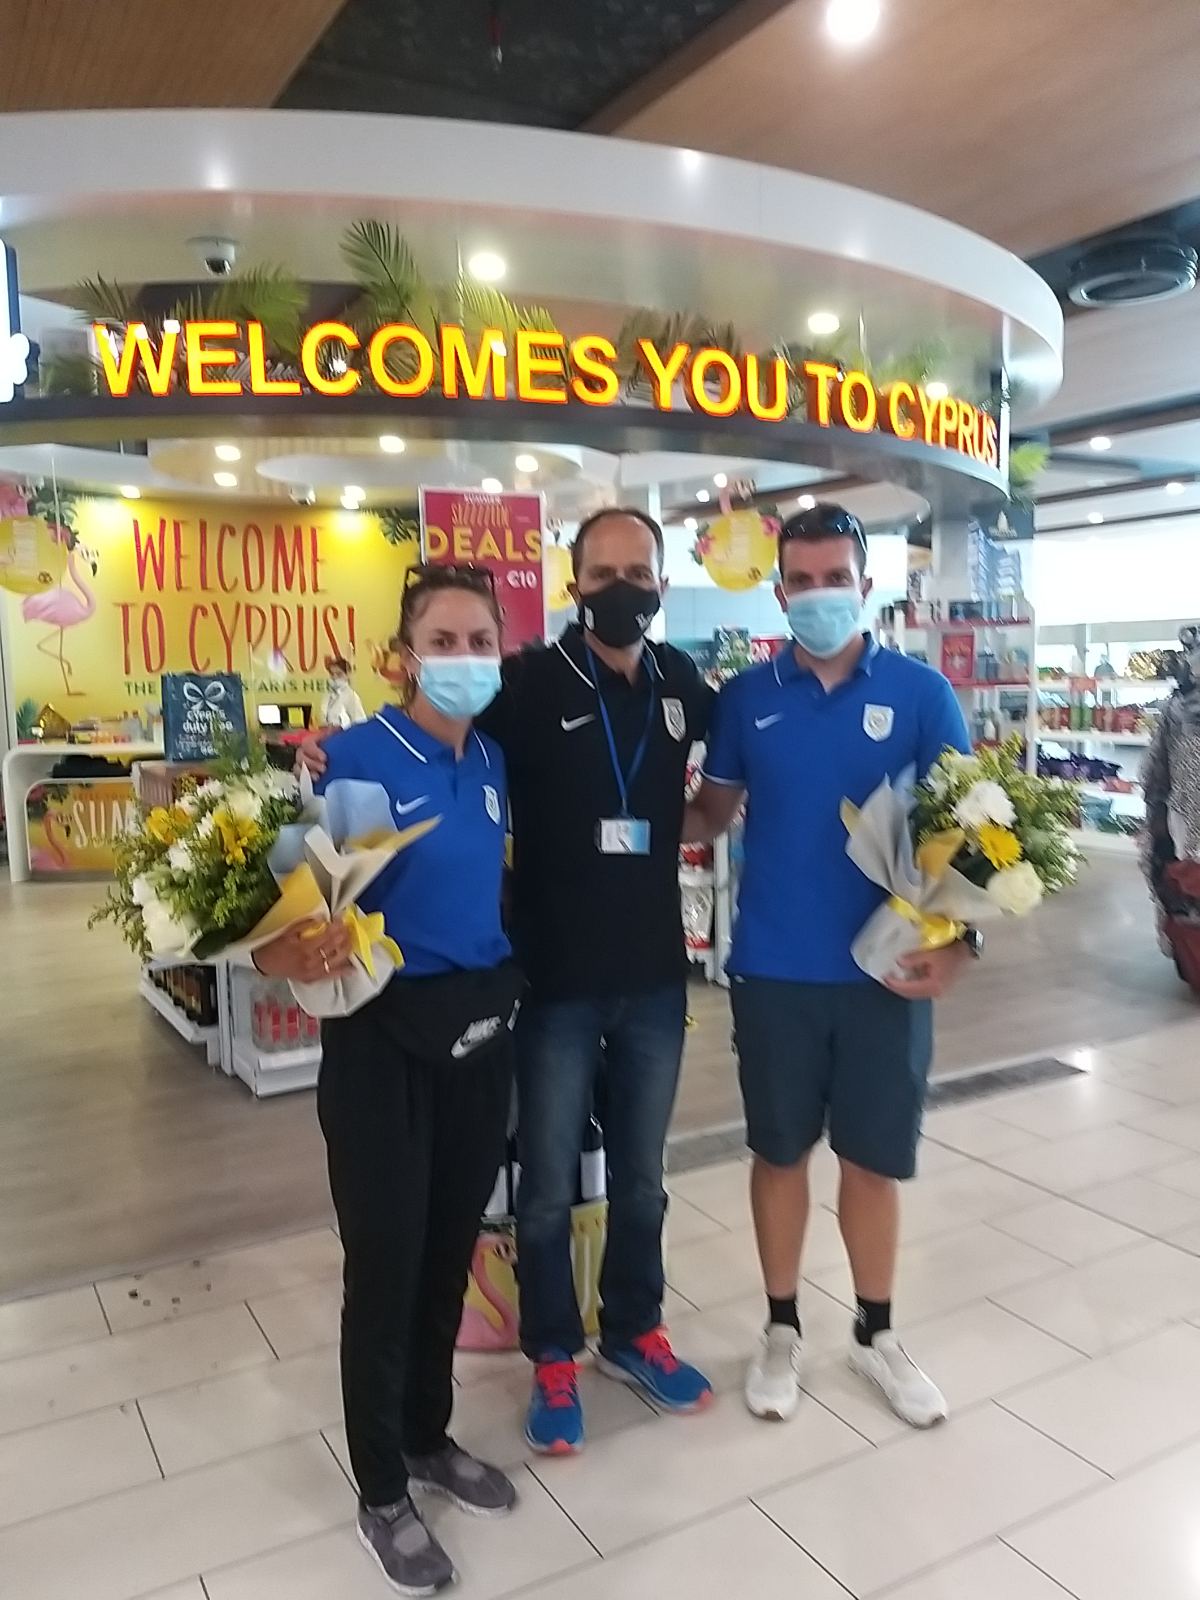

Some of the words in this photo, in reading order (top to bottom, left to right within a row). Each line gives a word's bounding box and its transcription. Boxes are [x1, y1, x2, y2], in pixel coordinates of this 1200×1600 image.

[93, 320, 620, 406] WELCOMES
[638, 339, 789, 421] YOU
[805, 361, 878, 433] TO
[889, 381, 999, 467] CYPRUS
[132, 518, 327, 594] WELCOME
[425, 525, 541, 562] DEALS
[114, 602, 166, 675] TO
[189, 602, 356, 673] CYPRUS!
[124, 681, 157, 696] THE
[73, 800, 136, 848] SUM
